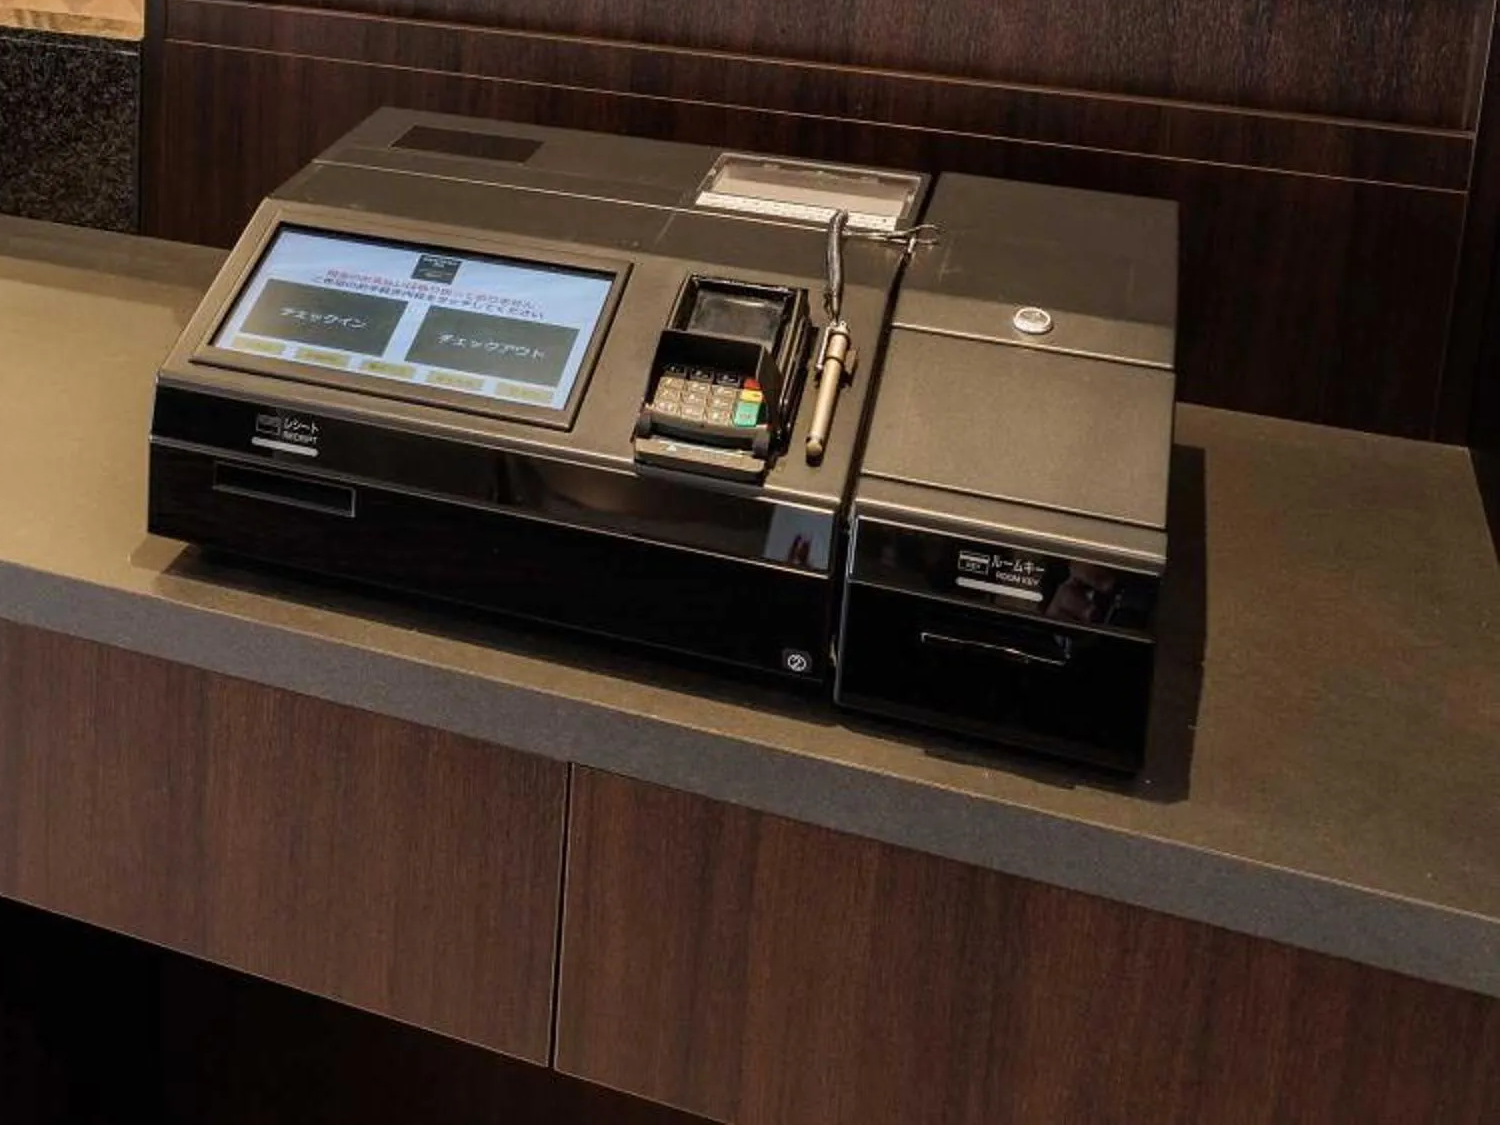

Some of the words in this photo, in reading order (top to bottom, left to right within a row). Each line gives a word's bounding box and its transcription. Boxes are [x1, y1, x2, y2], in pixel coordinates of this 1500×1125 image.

[279, 306, 368, 329] チェックイン
[437, 334, 545, 359] チェックアウト
[284, 418, 320, 434] レシート
[991, 554, 1045, 575] ルームキー
